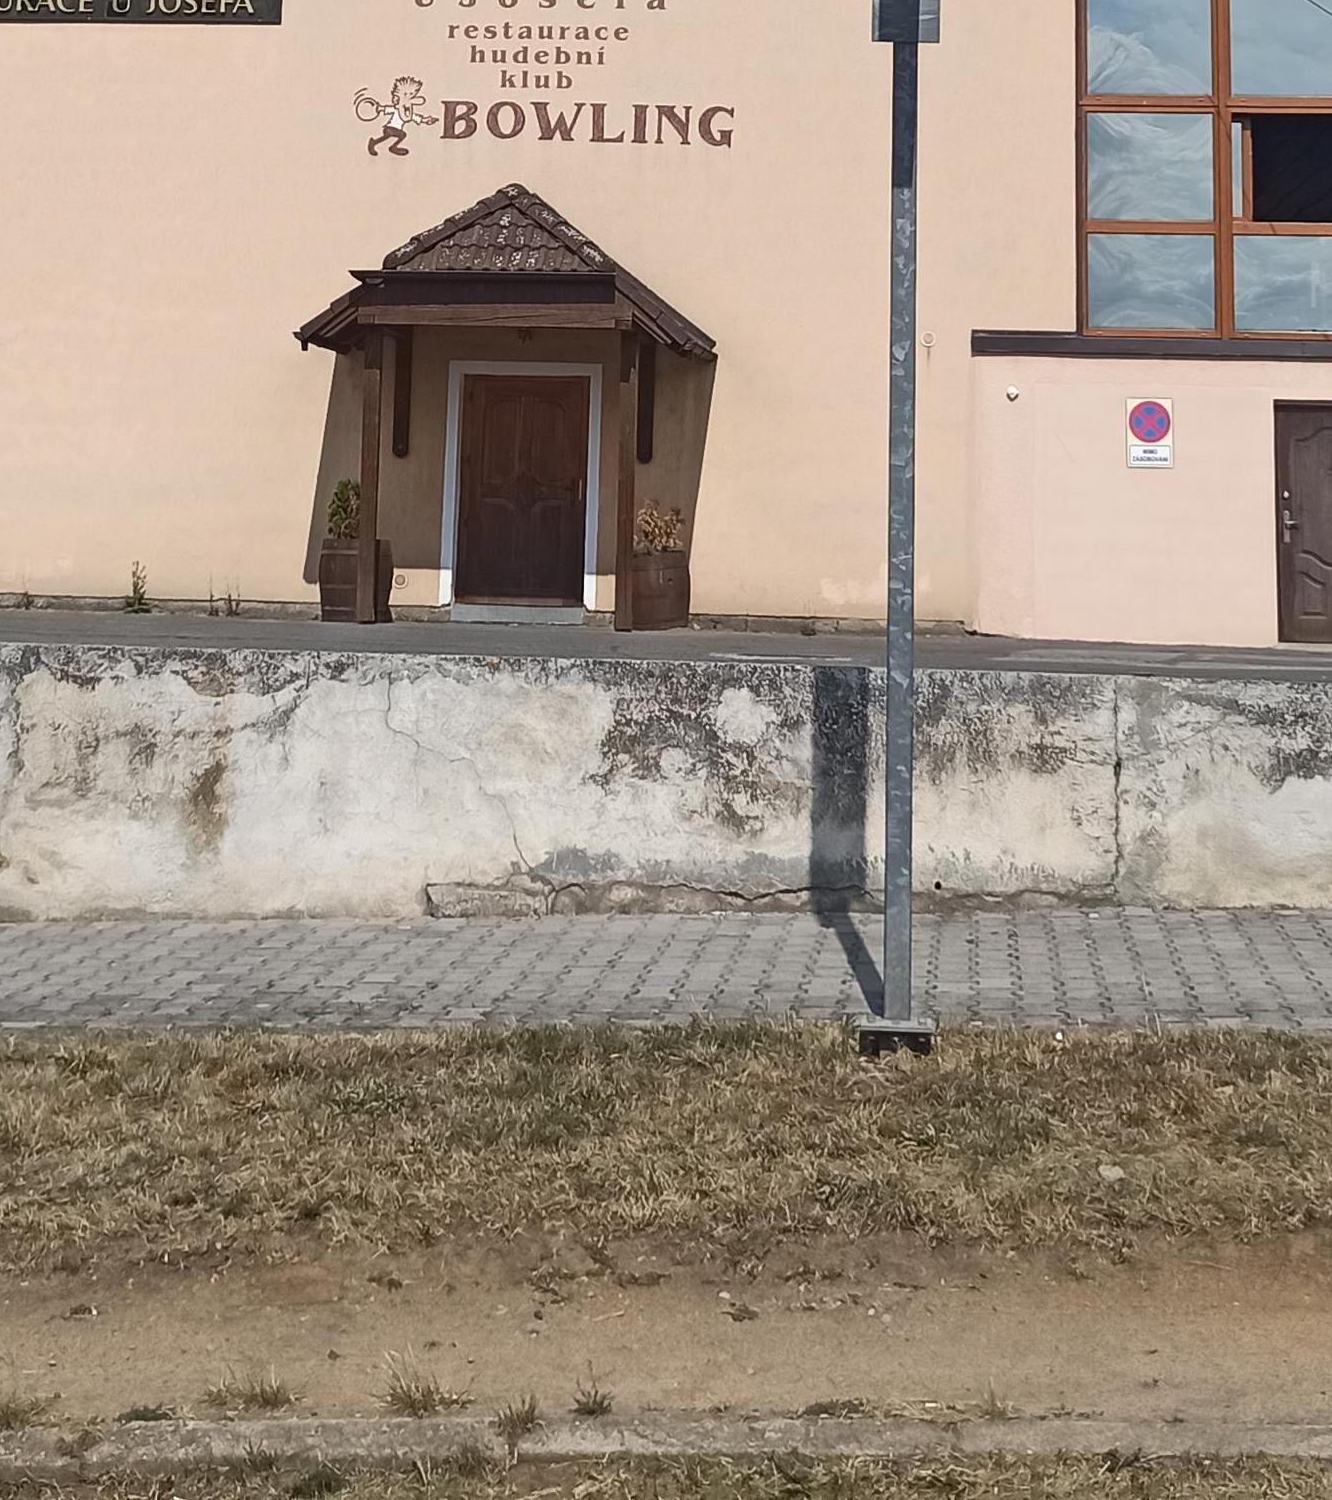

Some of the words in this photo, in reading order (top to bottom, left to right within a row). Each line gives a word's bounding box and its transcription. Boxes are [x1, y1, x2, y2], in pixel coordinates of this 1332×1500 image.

[447, 21, 630, 42] restaurace
[469, 45, 606, 66] hudební
[499, 70, 574, 90] klub
[439, 100, 736, 149] BOWLING
